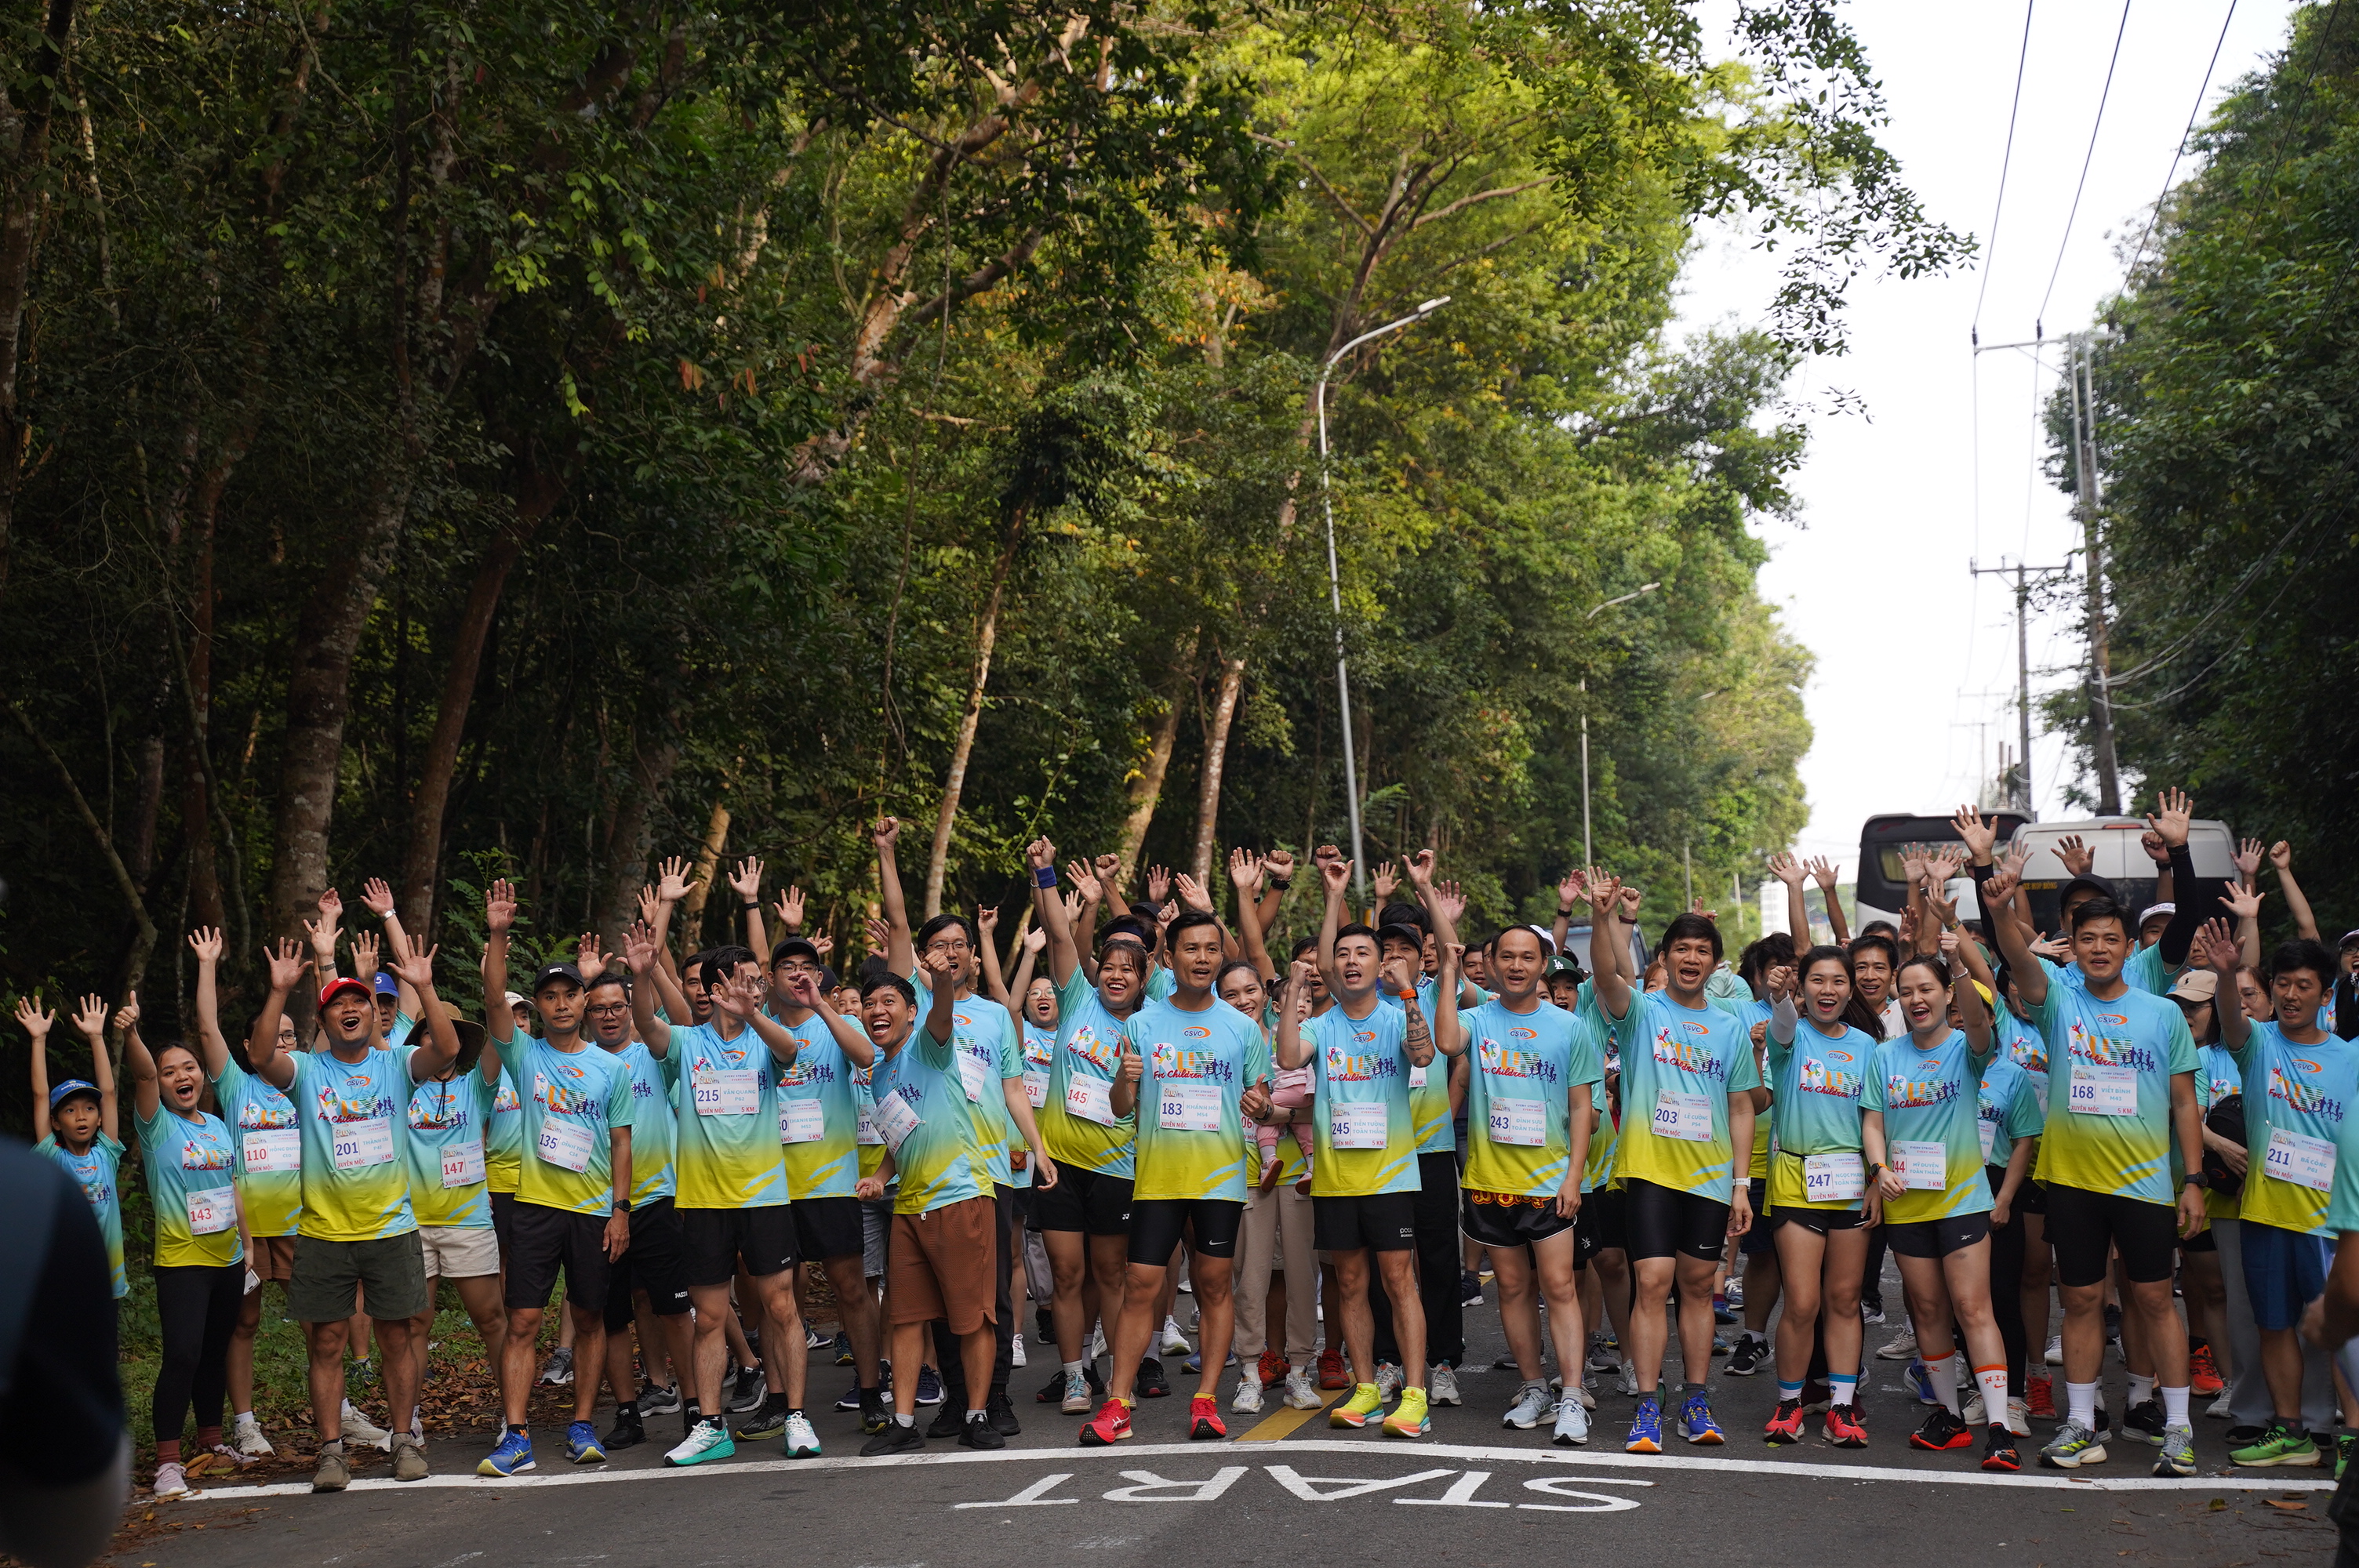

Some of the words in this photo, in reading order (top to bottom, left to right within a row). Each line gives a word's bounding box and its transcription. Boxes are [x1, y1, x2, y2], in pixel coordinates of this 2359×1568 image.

[1554, 960, 1564, 969] LA
[1683, 1024, 1701, 1033] CSVC
[2069, 1046, 2082, 1056] For
[1067, 1043, 1077, 1054] For
[1078, 1051, 1109, 1072] Children
[1654, 1054, 1667, 1064] For
[558, 1066, 576, 1076] CSVC
[2292, 1061, 2313, 1071] CSVC
[1167, 1069, 1204, 1078] Children
[1339, 1073, 1372, 1082] Children
[1492, 1067, 1528, 1078] Children
[698, 1090, 719, 1102] 215
[1068, 1089, 1087, 1103] 145
[1799, 1083, 1813, 1092] For
[1815, 1085, 1850, 1098] Children
[2072, 1085, 2094, 1098] 168
[2268, 1089, 2282, 1098] For
[534, 1094, 545, 1103] For
[1899, 1099, 1935, 1109] Children
[1162, 1102, 1182, 1115] 183
[318, 1112, 329, 1121] For
[1656, 1109, 1677, 1123] 203
[858, 1121, 870, 1132] 197
[1332, 1123, 1350, 1134] 245
[1491, 1116, 1509, 1129] 243
[540, 1134, 558, 1149] 135
[246, 1149, 266, 1161] 110
[336, 1142, 358, 1156] 201
[2268, 1149, 2290, 1166] 211
[444, 1162, 463, 1174] 147
[2266, 1167, 2280, 1177] XUYÊN
[2281, 1171, 2293, 1179] MỘC
[1808, 1174, 1831, 1188] 247
[191, 1208, 212, 1222] 143
[192, 1225, 208, 1233] XUYÊN
[954, 1465, 1656, 1512] START
